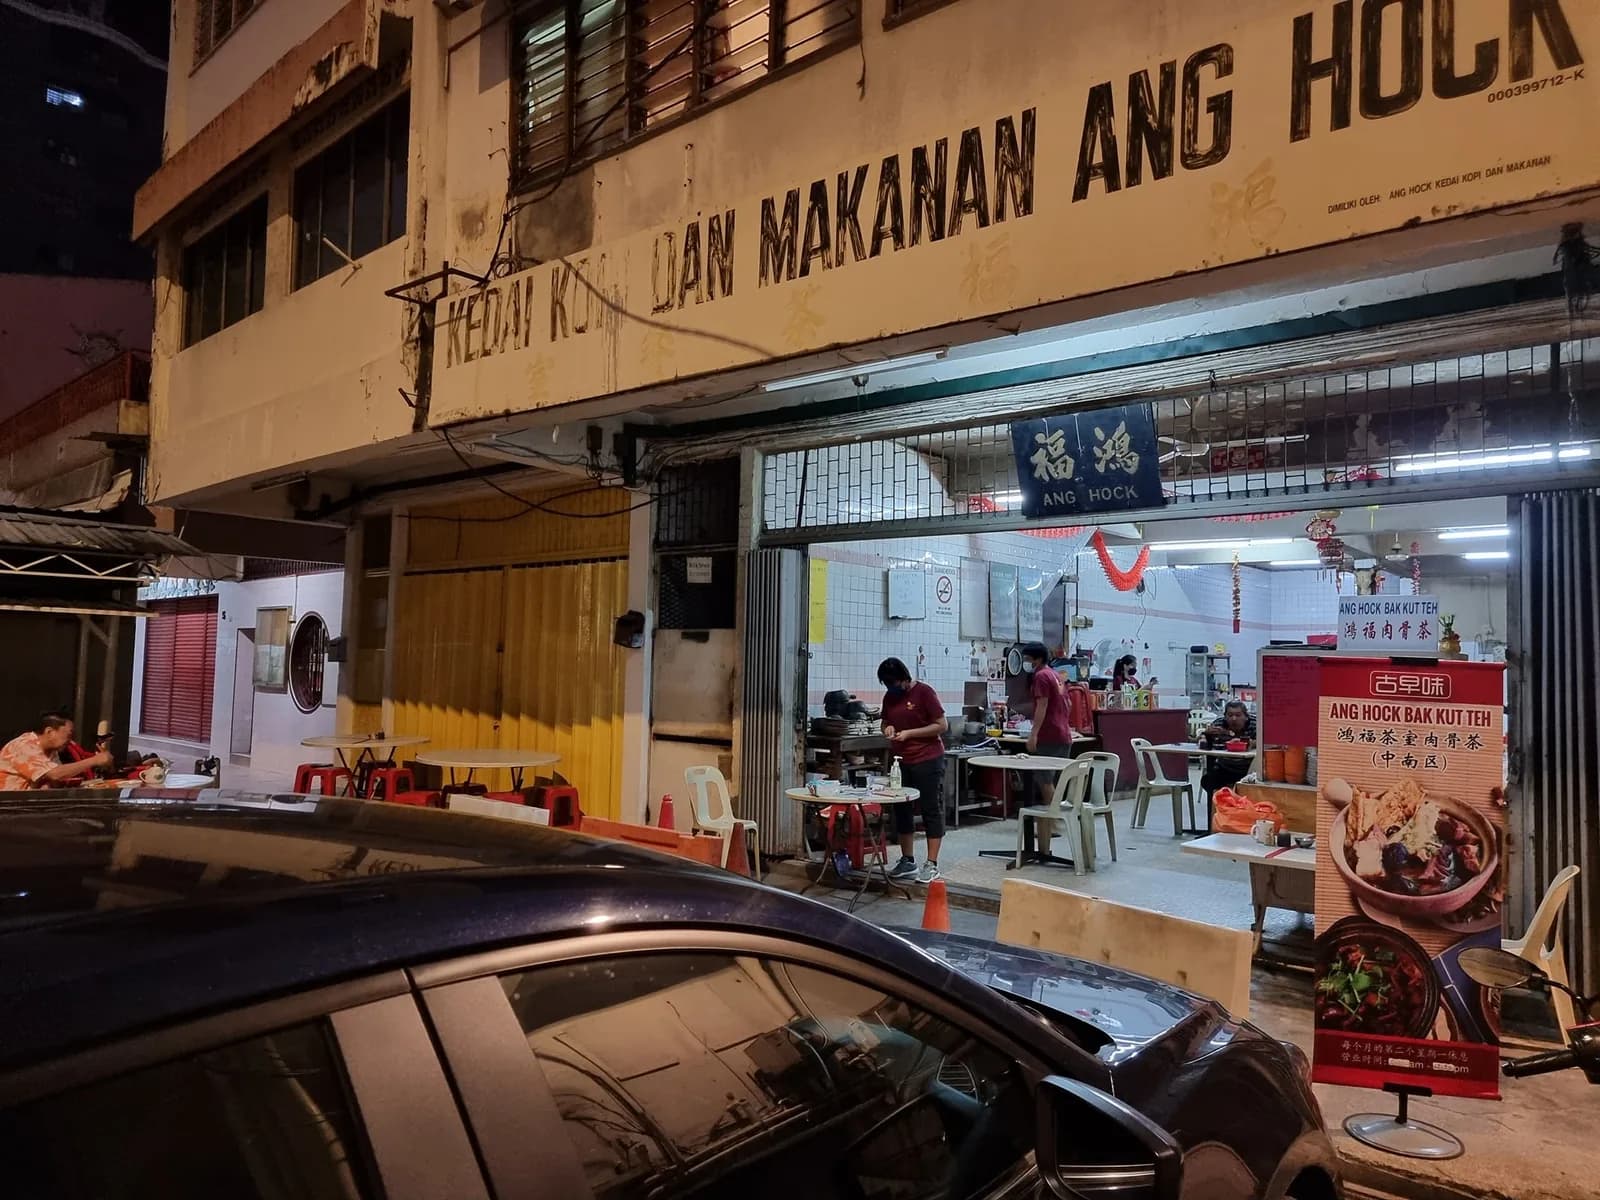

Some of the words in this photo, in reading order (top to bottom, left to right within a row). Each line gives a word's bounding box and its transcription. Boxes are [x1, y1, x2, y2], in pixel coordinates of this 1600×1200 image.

[1487, 69, 1585, 103] 000399712-K
[651, 207, 735, 313] DAN
[759, 107, 1037, 288] MAKANAN
[1072, 43, 1234, 203] ANG
[1290, 0, 1584, 143] HOCK
[1328, 200, 1357, 214] DIMILIKI
[1389, 188, 1406, 200] ANG
[1409, 182, 1432, 195] HOCK
[1435, 176, 1459, 190] KEDAI
[1462, 171, 1481, 184] KOPI
[1485, 165, 1503, 178] DAN
[1044, 490, 1076, 506] ANG
[1089, 485, 1139, 502] HOCK
[1339, 602, 1356, 615] ANG
[1358, 602, 1381, 615] HOCK
[1385, 602, 1400, 614] BAK
[1402, 601, 1421, 614] KUT
[1421, 601, 1438, 614] TEH
[1375, 674, 1444, 696] 古早味
[1330, 703, 1359, 720] ANG
[1362, 704, 1401, 723] HOCK
[1404, 706, 1433, 725] BAK
[1436, 708, 1463, 726] KUT
[1466, 710, 1492, 727] TEH
[1337, 726, 1484, 751] 鸿福茶室肉骨茶
